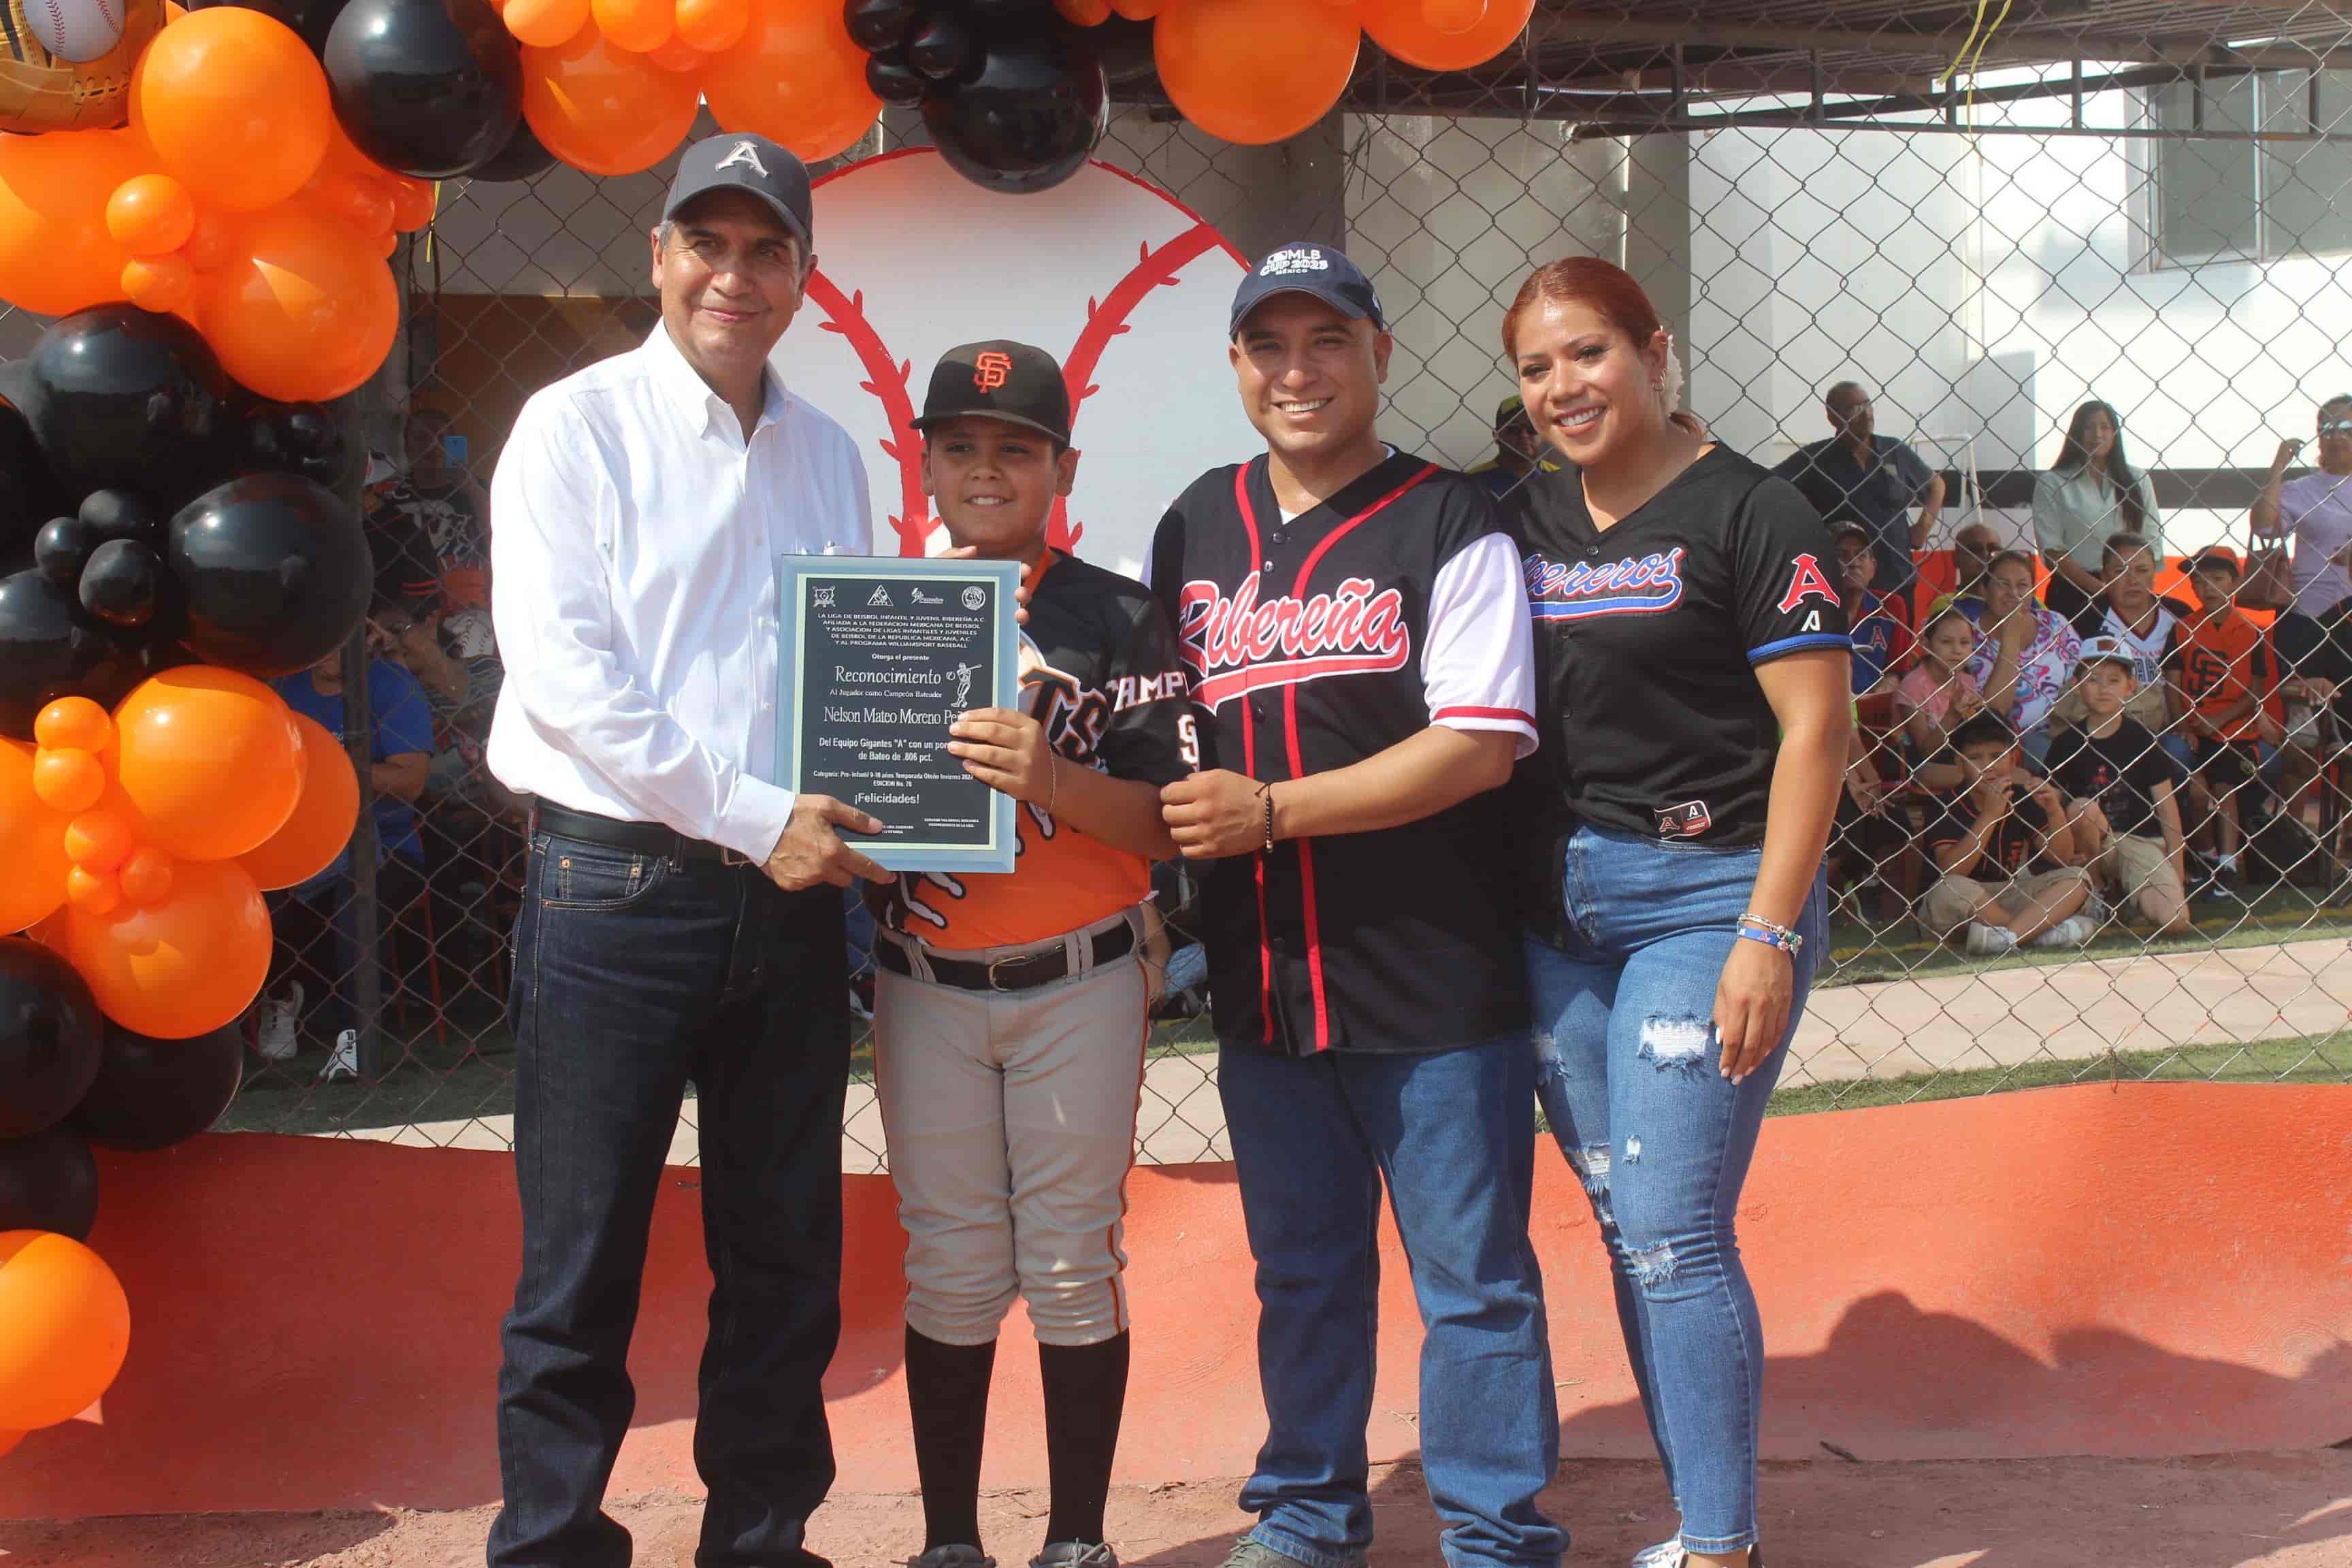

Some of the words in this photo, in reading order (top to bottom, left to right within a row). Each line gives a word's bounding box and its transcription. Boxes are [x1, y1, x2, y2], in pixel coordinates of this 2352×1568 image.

[715, 140, 772, 179] A
[1288, 248, 1321, 260] MLB
[1260, 260, 1290, 276] CUP
[1777, 553, 1840, 615] A
[1179, 570, 1405, 679] Ribereña
[834, 665, 941, 685] Reconocimiento
[823, 706, 861, 722] Nelson
[863, 707, 898, 723] Mateo
[900, 708, 941, 725] Moreno
[819, 737, 832, 747] Del
[832, 737, 858, 749] Equipo
[860, 738, 892, 749] Gigantes
[858, 751, 868, 760] de
[869, 751, 890, 761] Bateo
[892, 751, 901, 761] de
[854, 791, 919, 805] ¡Felicidades!
